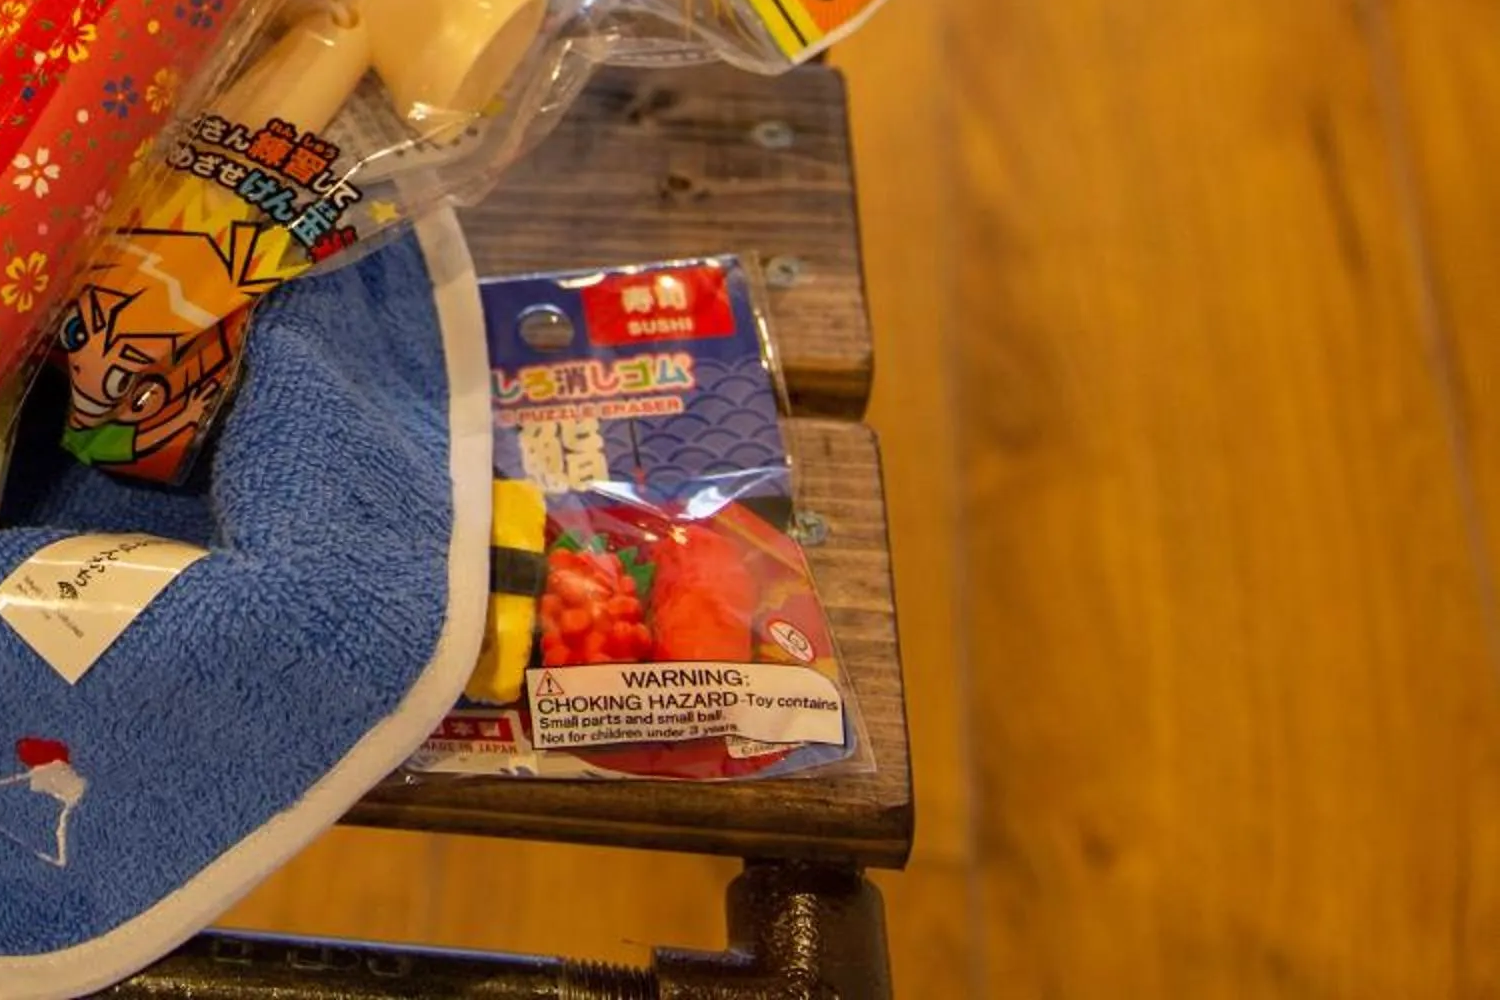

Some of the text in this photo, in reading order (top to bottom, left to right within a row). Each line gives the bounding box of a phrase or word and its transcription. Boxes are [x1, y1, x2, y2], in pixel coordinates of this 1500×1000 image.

[627, 317, 693, 336] SUSHI
[519, 407, 595, 422] PUZZLE
[601, 399, 682, 415] ERASER
[621, 669, 750, 689] WARNING:
[538, 695, 642, 714] CHOKING
[777, 697, 838, 712] contains
[539, 714, 579, 728] Small
[582, 714, 621, 728] parts
[625, 712, 654, 725] and
[657, 711, 694, 723] small
[540, 732, 565, 744] Not
[568, 732, 586, 743] for
[589, 728, 643, 741] children
[647, 727, 684, 739] under
[476, 743, 518, 756] JAPAN
